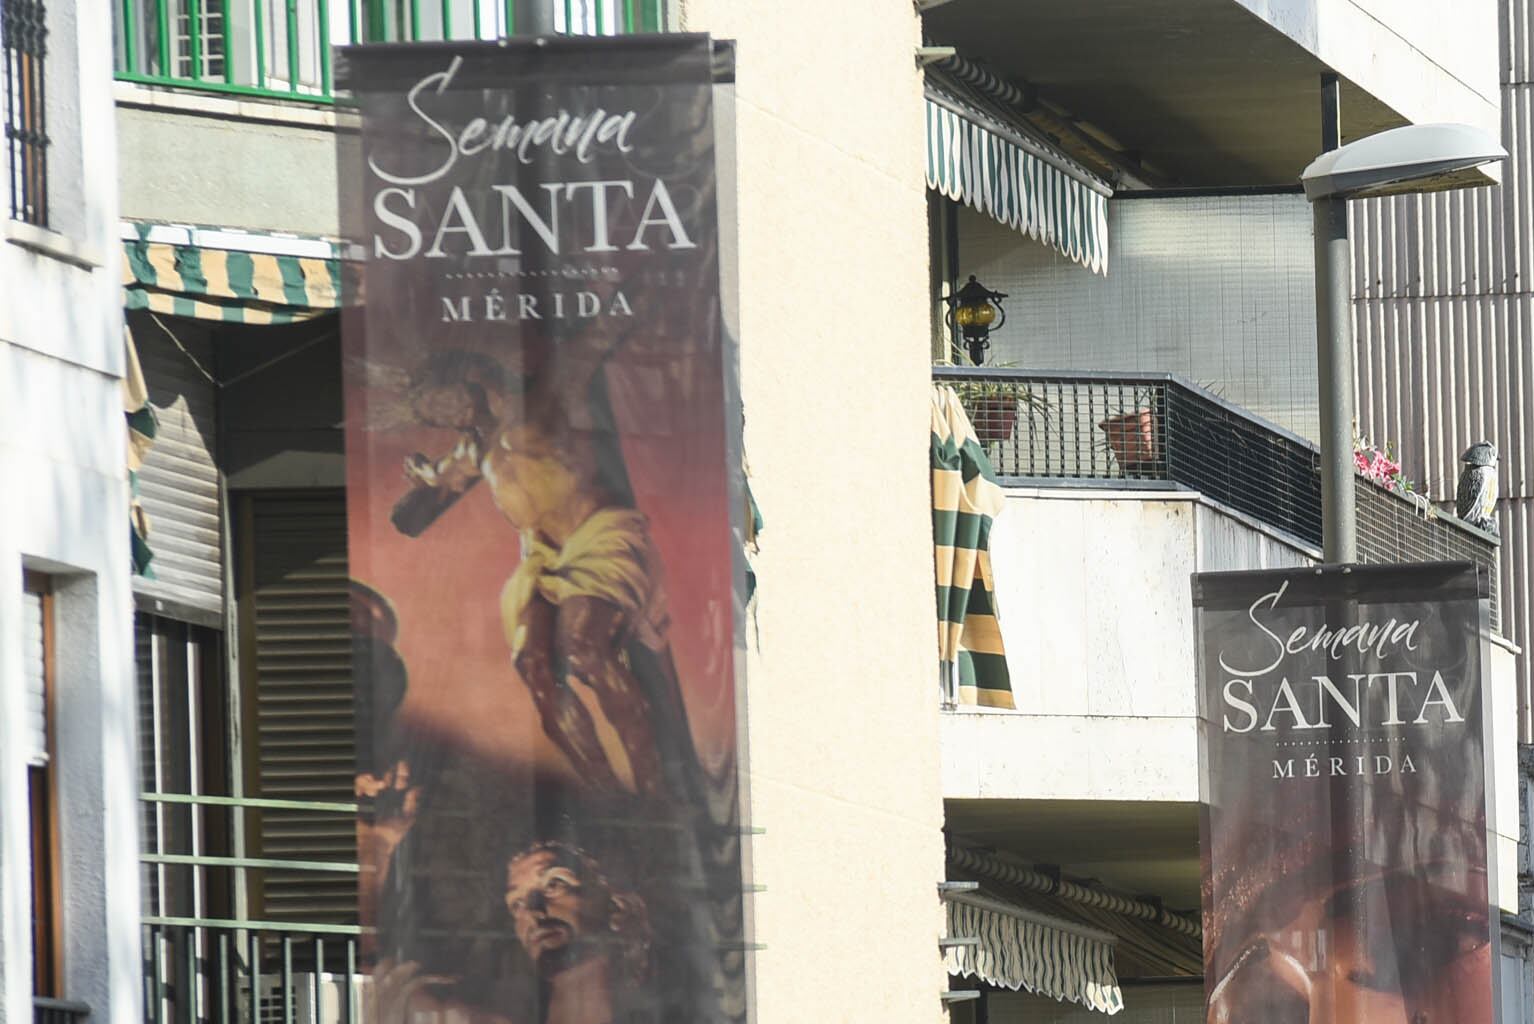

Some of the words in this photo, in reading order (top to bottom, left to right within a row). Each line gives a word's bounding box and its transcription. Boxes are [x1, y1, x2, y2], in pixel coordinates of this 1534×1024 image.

[367, 55, 637, 185] Semana
[373, 177, 697, 260] SANTA
[441, 288, 633, 322] MÉRIDA
[1219, 579, 1420, 677] Semana
[1222, 669, 1465, 733] SANTA
[1271, 753, 1417, 779] MÉRIDA
